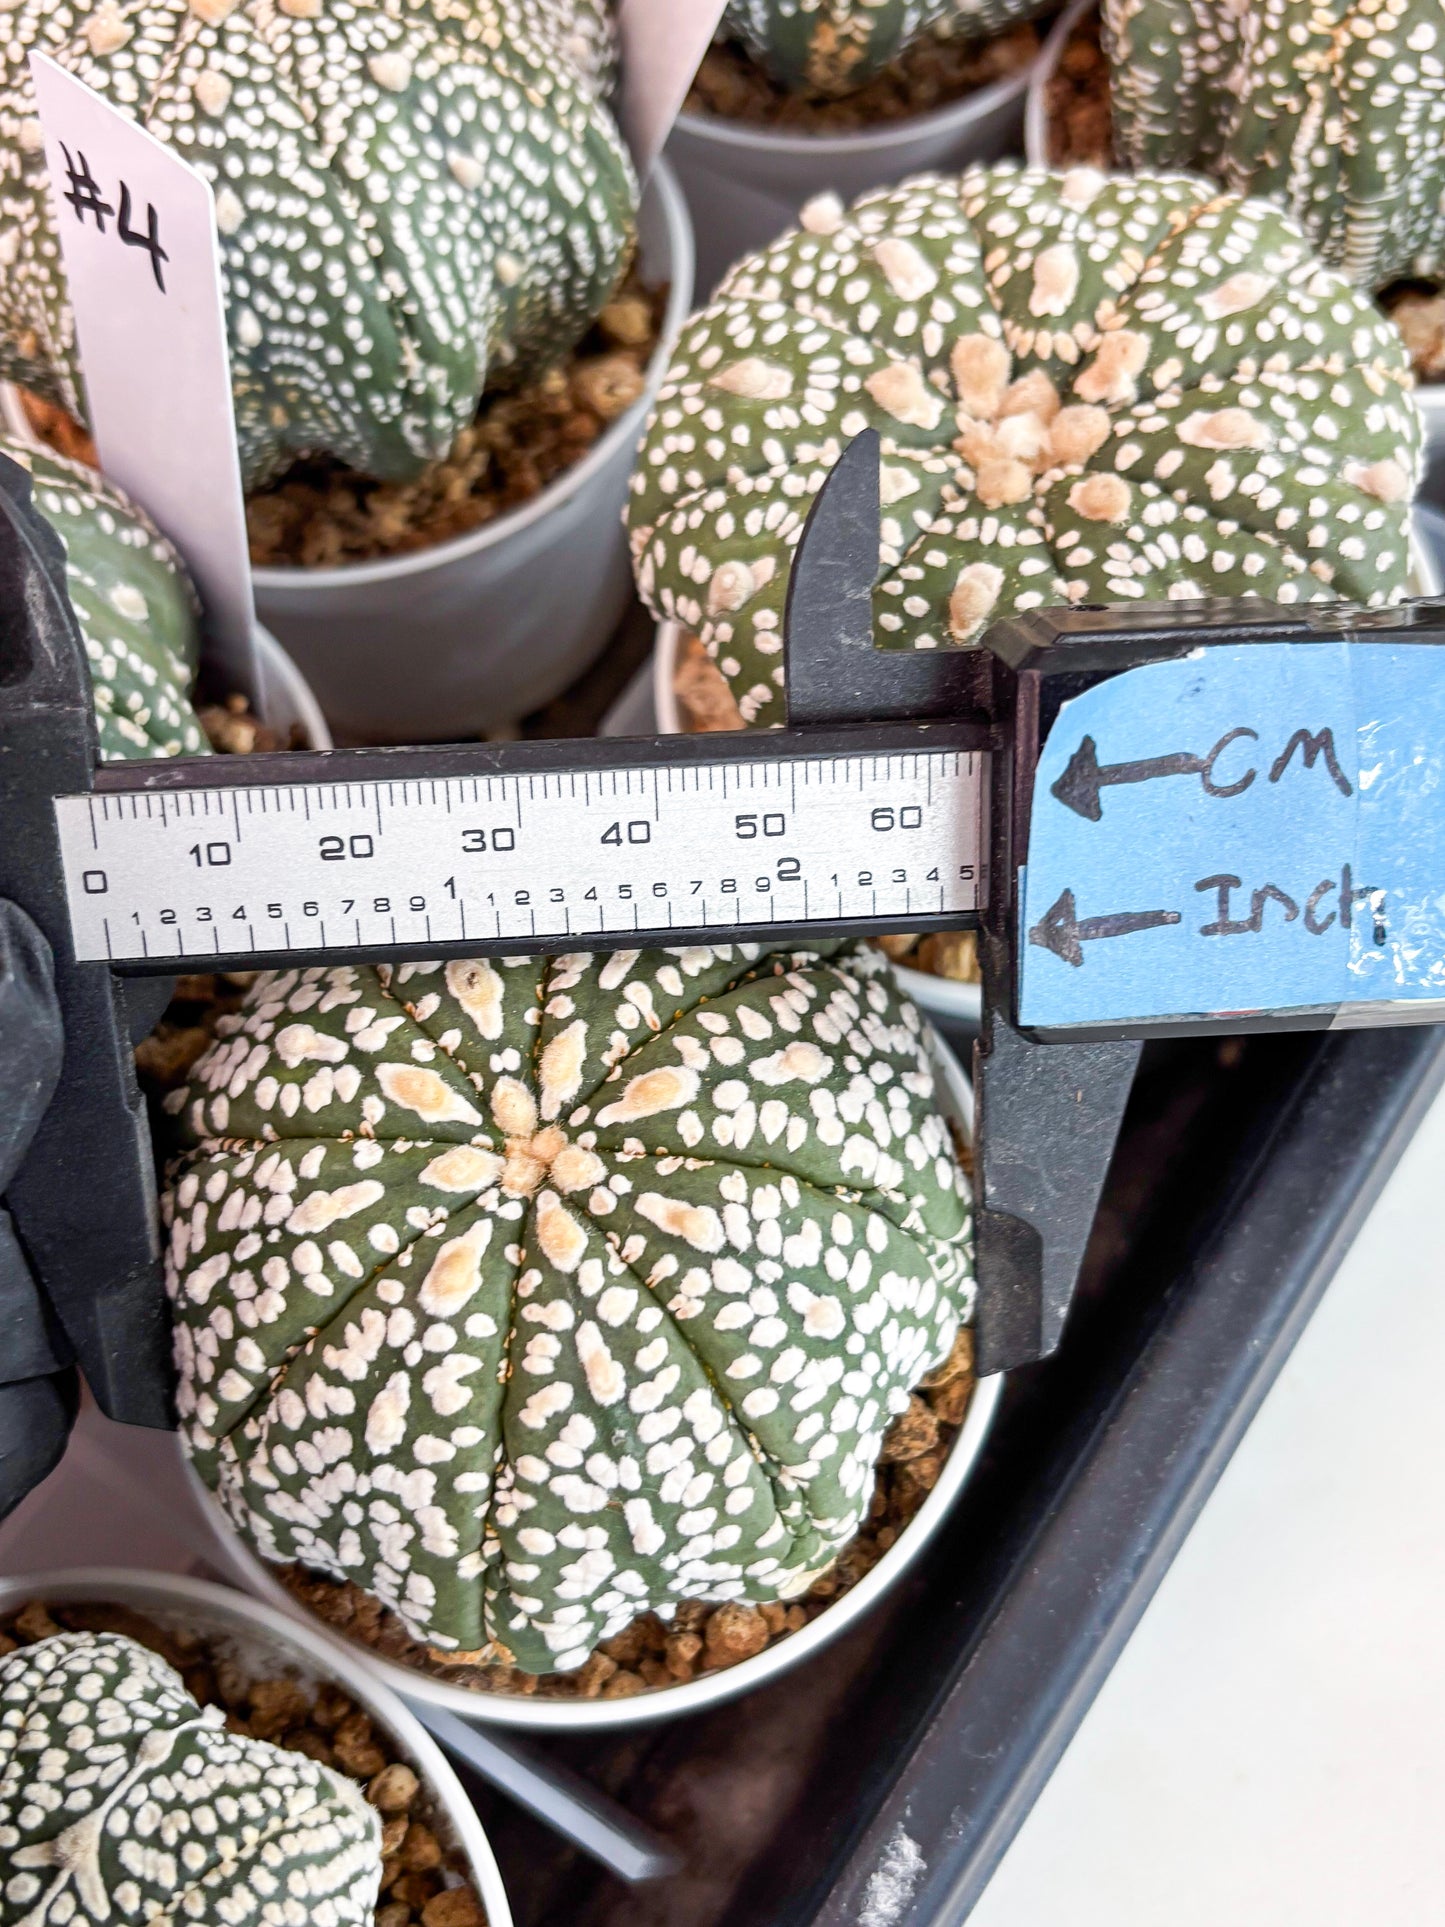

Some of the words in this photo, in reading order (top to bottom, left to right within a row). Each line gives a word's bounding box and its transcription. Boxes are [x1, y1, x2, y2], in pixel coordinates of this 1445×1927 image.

[58, 140, 170, 295] #4
[1201, 726, 1354, 798] CM
[82, 869, 108, 894] 0
[189, 841, 231, 868] 10
[318, 834, 374, 861] 20
[461, 827, 515, 853] 30
[600, 820, 651, 847] 40
[735, 812, 786, 839] 50
[871, 805, 922, 832] 60
[131, 911, 141, 926] 1
[159, 908, 177, 925] 2
[195, 907, 213, 922] 3
[232, 905, 247, 921] 4
[267, 903, 283, 919] 5
[303, 901, 319, 917] 6
[340, 899, 355, 915] 7
[373, 897, 391, 913] 8
[409, 895, 426, 912] 9
[443, 875, 456, 900] 1
[486, 892, 495, 907] 1
[514, 889, 531, 906] 2
[549, 887, 565, 903] 3
[584, 886, 598, 902] 4
[618, 884, 633, 900] 5
[652, 882, 668, 898] 6
[689, 880, 703, 895] 7
[720, 878, 737, 894] 8
[755, 876, 771, 893] 9
[776, 856, 801, 882] 2
[830, 873, 838, 888] 1
[857, 870, 873, 886] 2
[891, 868, 907, 884] 3
[925, 866, 940, 882] 4
[959, 864, 975, 881] 5
[1194, 863, 1386, 946] Inch
